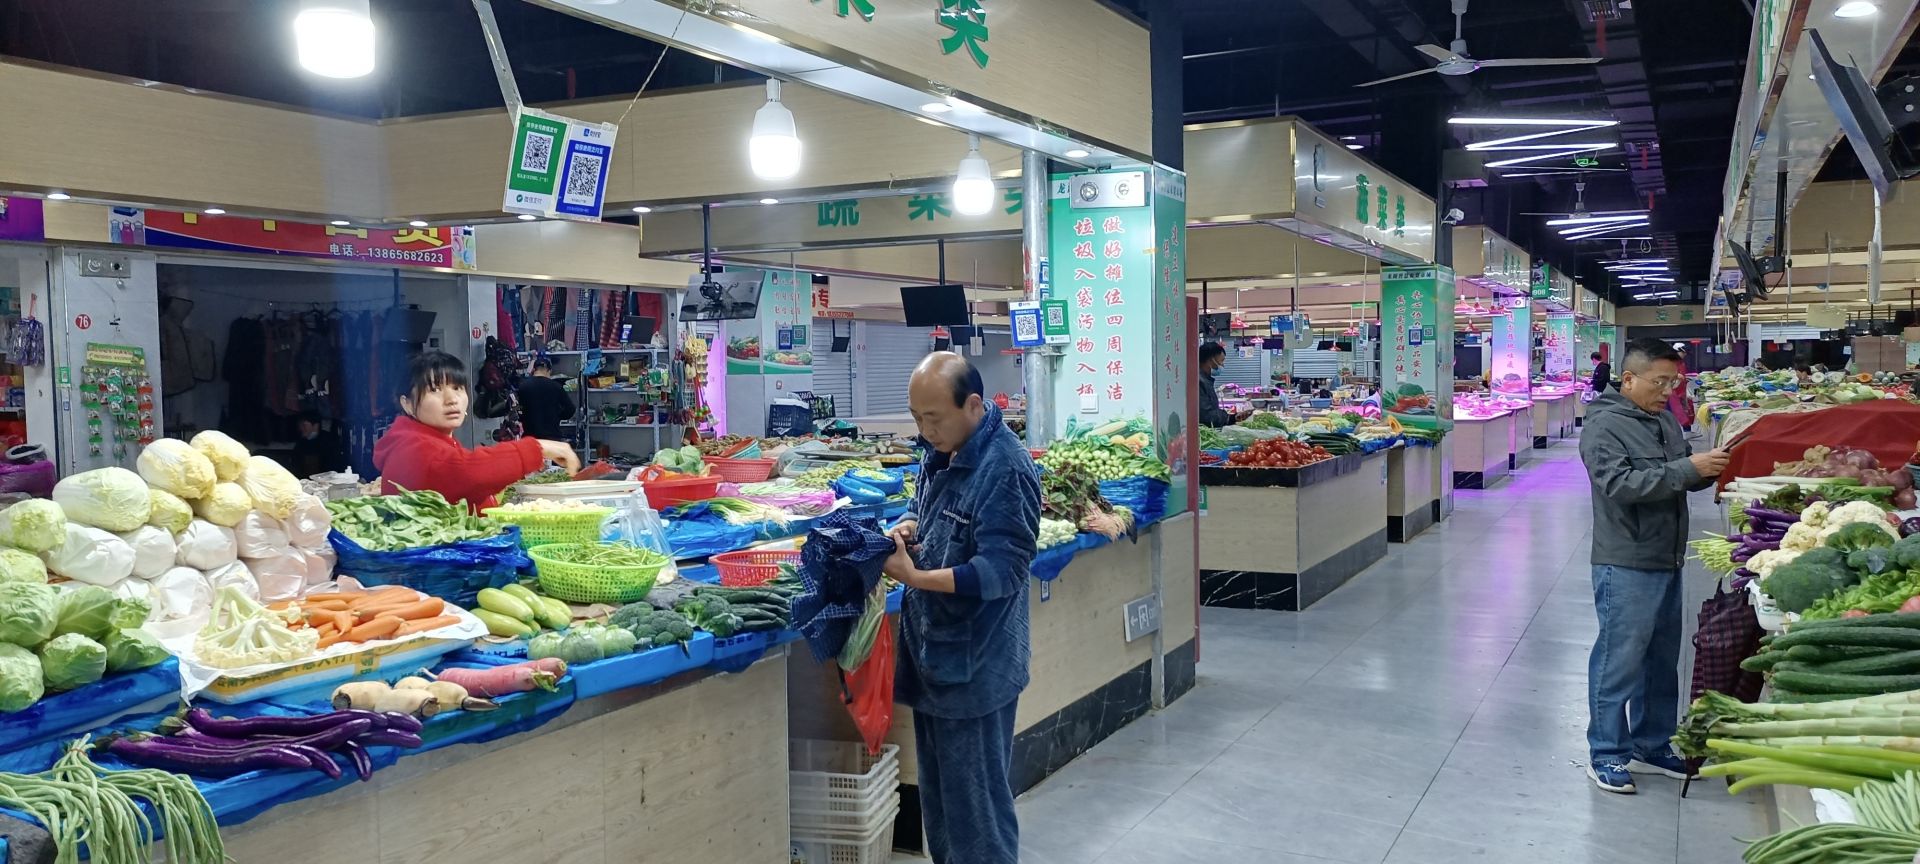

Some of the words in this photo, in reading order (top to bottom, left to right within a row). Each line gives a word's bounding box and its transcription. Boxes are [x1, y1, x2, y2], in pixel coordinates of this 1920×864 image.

[79, 316, 89, 328] 76
[1103, 216, 1124, 400] 做好摊位四周保洁
